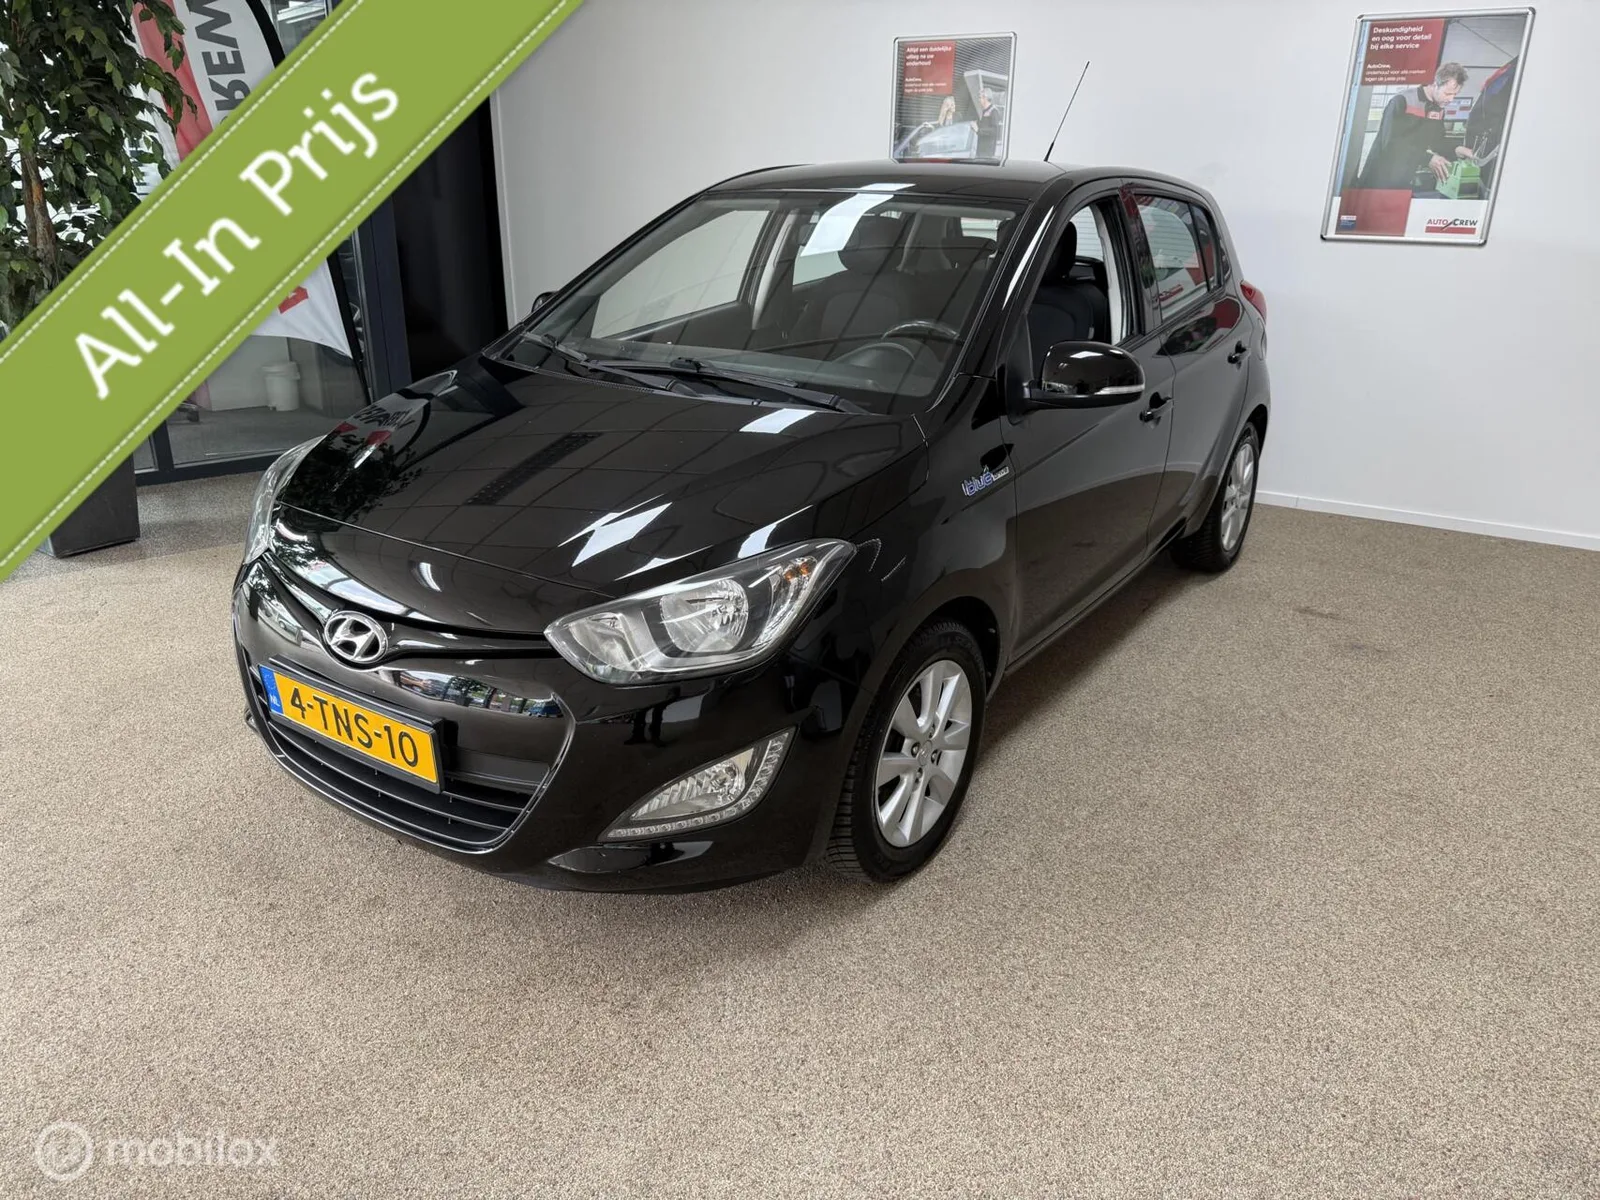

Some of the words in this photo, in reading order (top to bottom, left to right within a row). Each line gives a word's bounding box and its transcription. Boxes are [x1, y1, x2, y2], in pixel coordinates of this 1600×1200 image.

[1453, 218, 1478, 226] CREW
[270, 694, 280, 707] NL
[290, 687, 419, 768] 4-TNS-10
